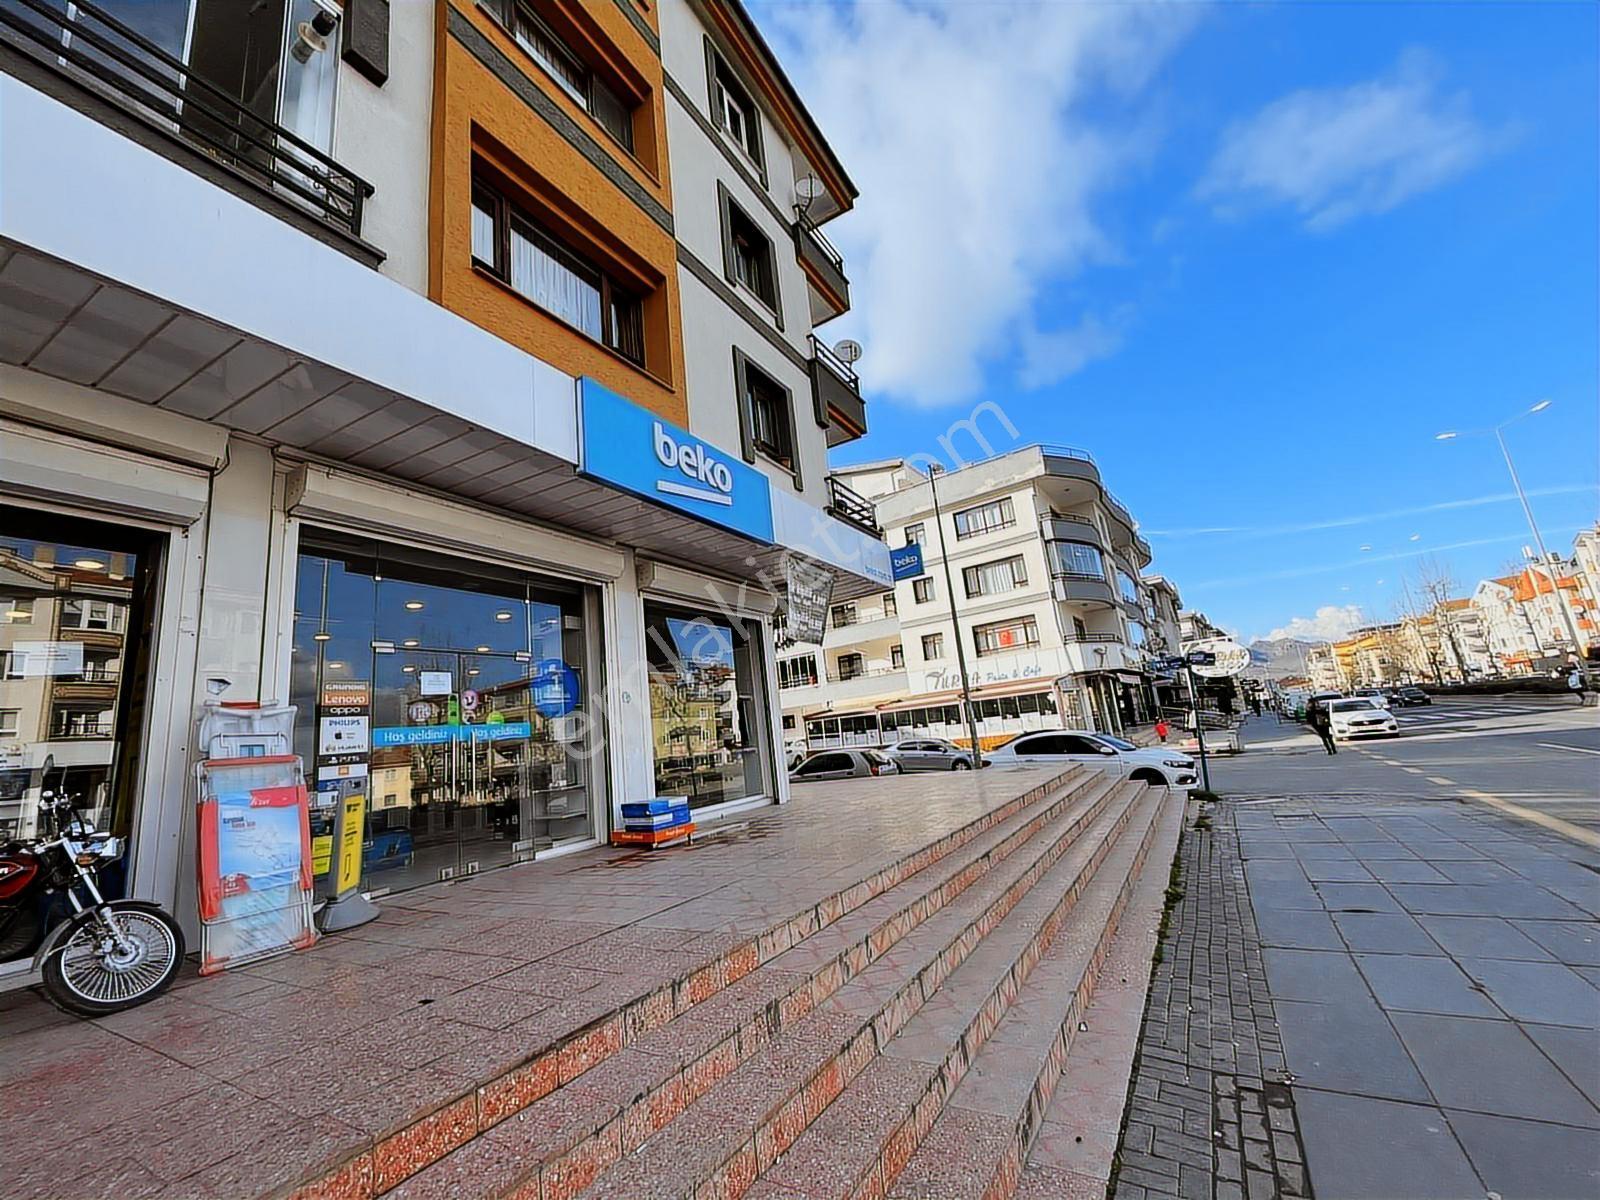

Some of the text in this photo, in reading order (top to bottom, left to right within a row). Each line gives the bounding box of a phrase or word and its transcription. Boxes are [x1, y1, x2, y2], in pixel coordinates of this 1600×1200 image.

[653, 420, 733, 493] beko
[894, 555, 918, 568] beko
[925, 667, 981, 690] TURA
[324, 694, 366, 704] Lenovo
[383, 728, 448, 743] Hoş geldiniz
[490, 724, 523, 739] geldiniz
